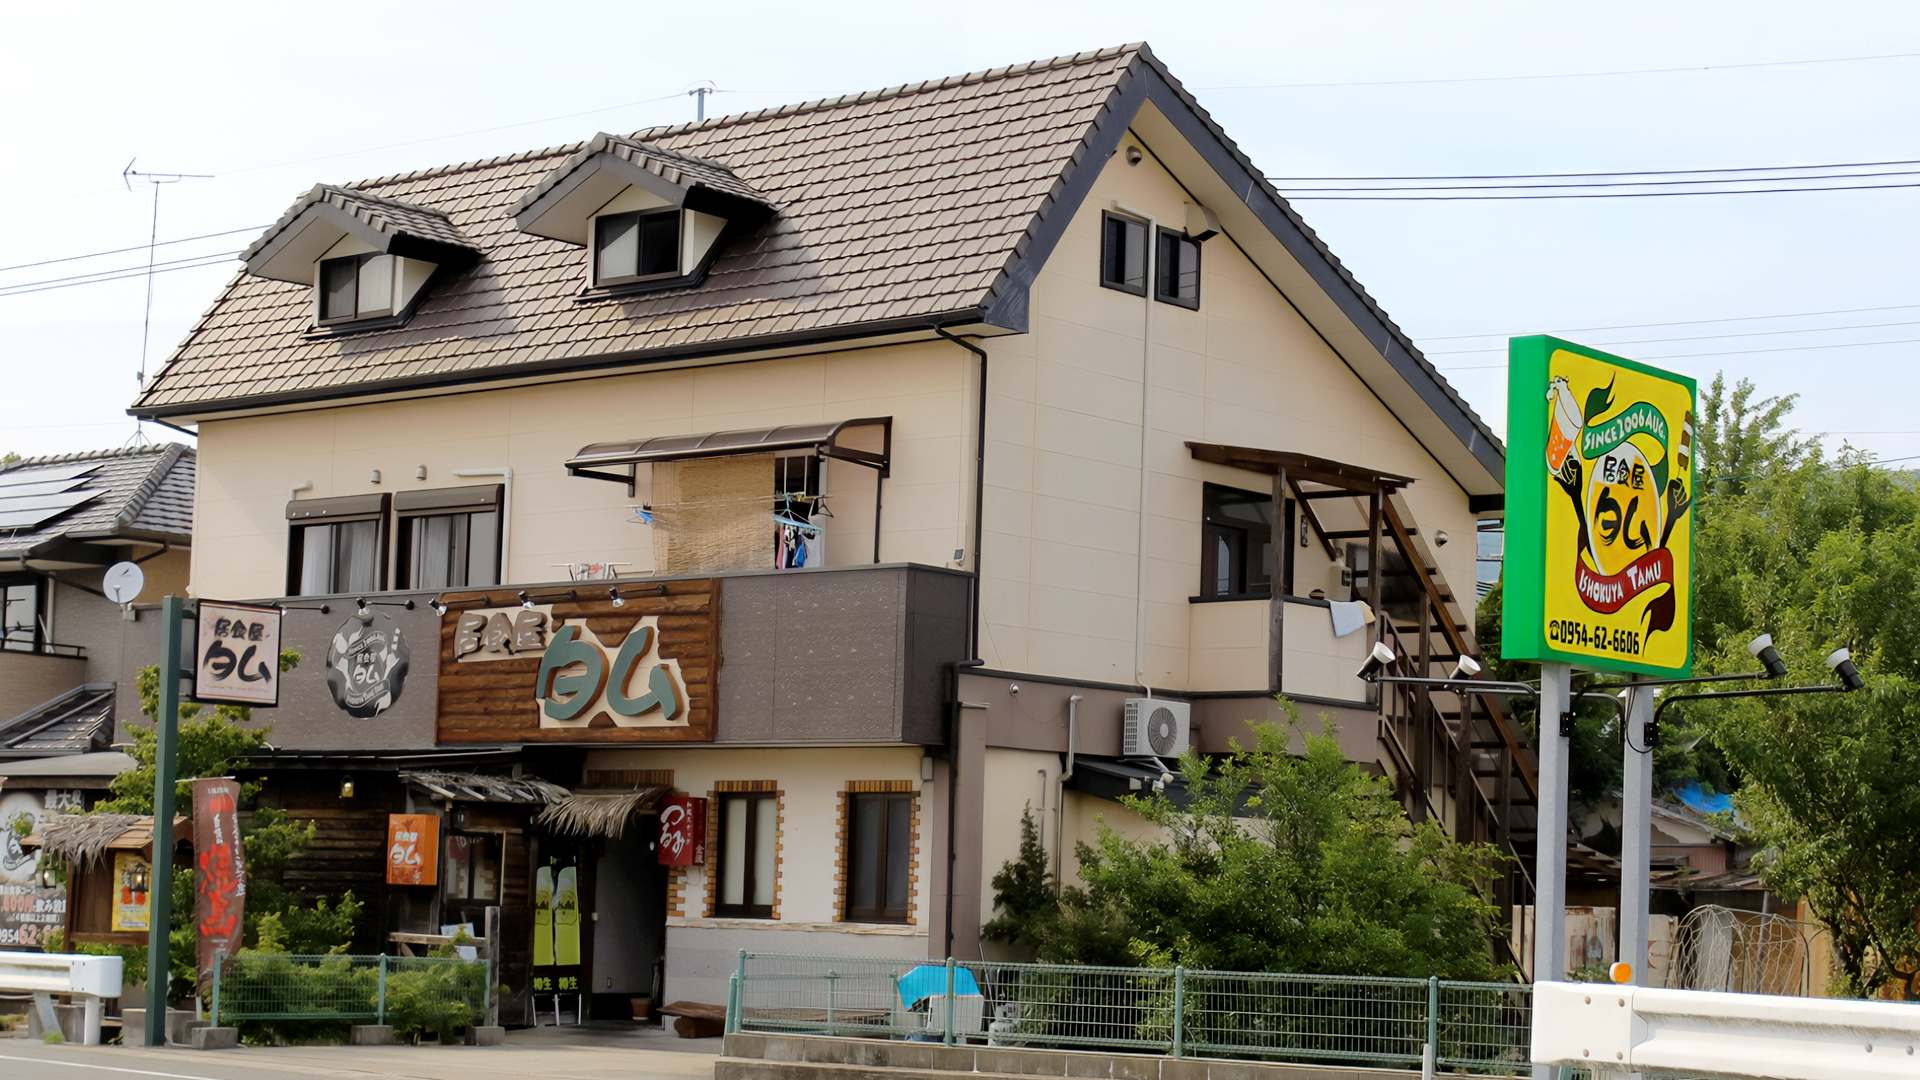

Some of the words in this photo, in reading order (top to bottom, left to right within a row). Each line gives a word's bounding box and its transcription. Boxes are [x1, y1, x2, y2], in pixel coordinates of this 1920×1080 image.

[1583, 425, 1618, 451] SINCE
[1617, 408, 1645, 440] 2006
[1604, 454, 1645, 490] 居食屋
[1579, 568, 1624, 604] ISHOKUYA
[1626, 560, 1662, 591] TAMU
[214, 616, 265, 642] 居食屋
[454, 609, 548, 658] 居食屋
[1560, 619, 1640, 656] 0954-62-6606
[660, 804, 686, 860] つるみ
[0, 927, 20, 944] 954
